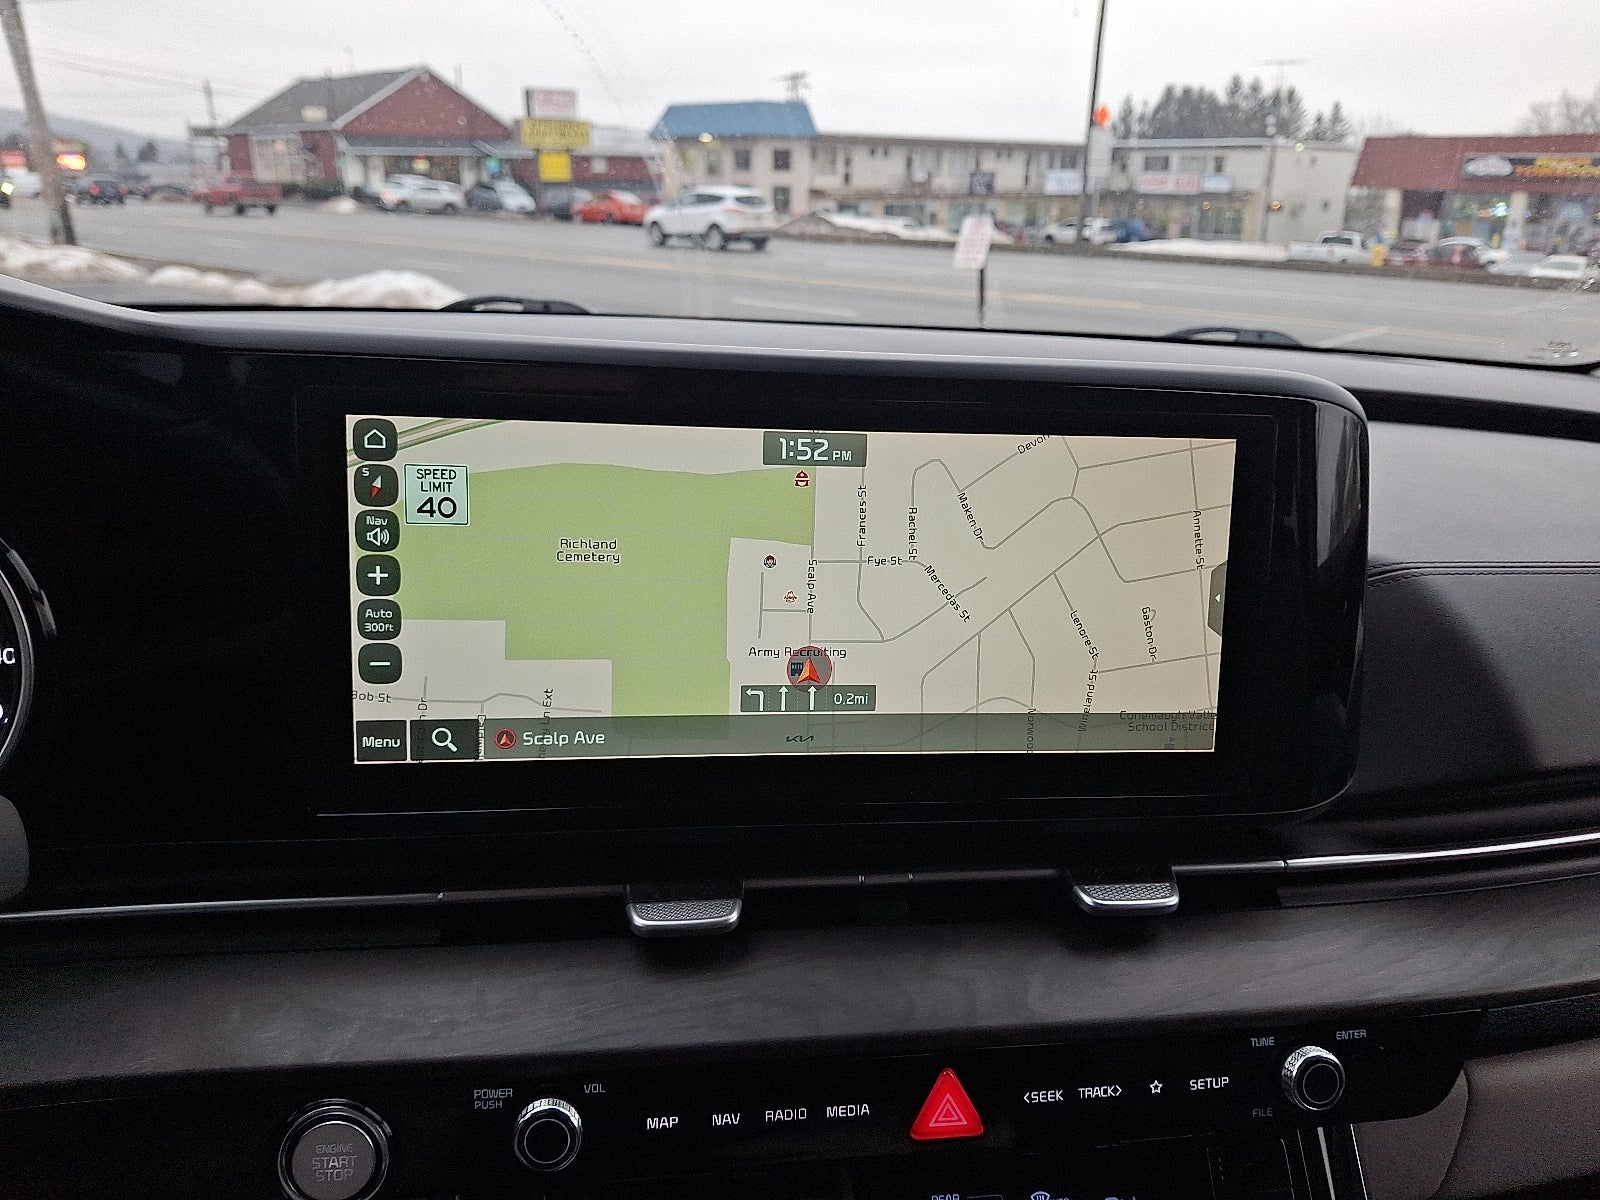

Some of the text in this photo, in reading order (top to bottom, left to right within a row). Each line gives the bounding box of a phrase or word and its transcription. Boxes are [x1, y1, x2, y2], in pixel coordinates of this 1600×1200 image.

[779, 438, 852, 461] 1:52 PM
[361, 468, 370, 477] S
[416, 469, 457, 479] SPEED
[420, 482, 453, 492] LIMIT
[416, 496, 457, 518] 40
[365, 516, 388, 525] Nav
[857, 485, 867, 547] Frances St
[957, 492, 984, 541] Maken Dr
[908, 507, 918, 560] Rachel St
[1193, 510, 1205, 570] Annette St
[560, 538, 617, 550] Richland
[556, 551, 620, 564] Cemetery
[867, 556, 903, 567] Fye St
[806, 559, 818, 614] Scalp Ave
[365, 609, 393, 618] Auto
[958, 609, 971, 623] St
[364, 622, 394, 632] 300ft
[1141, 606, 1158, 660] Gaston Dr
[1070, 610, 1100, 660] Lenore St
[748, 647, 847, 659] Army Recruiting
[1088, 669, 1099, 681] St
[378, 692, 392, 703] St
[543, 688, 554, 708] Ext
[833, 692, 869, 706] 0.2mi
[1026, 708, 1037, 753] Norwoo
[1128, 721, 1168, 732] School
[362, 736, 401, 748] Menu
[523, 732, 569, 747] Scalp
[573, 731, 605, 744] Ave
[1250, 1036, 1275, 1048] TUNE
[1336, 1030, 1367, 1041] ENTER
[584, 1083, 606, 1094] VOL
[1189, 1076, 1230, 1091] SETUP
[474, 1088, 513, 1099] POWER
[474, 1100, 503, 1110] PUSH
[826, 1103, 870, 1119] MEDIA
[712, 1112, 740, 1126] NAV
[765, 1108, 807, 1123] RADIO
[1252, 1107, 1273, 1118] FILE
[646, 1116, 679, 1130] MAP
[315, 1143, 353, 1154] ENGINE
[311, 1155, 358, 1169] START
[315, 1169, 354, 1182] STOP
